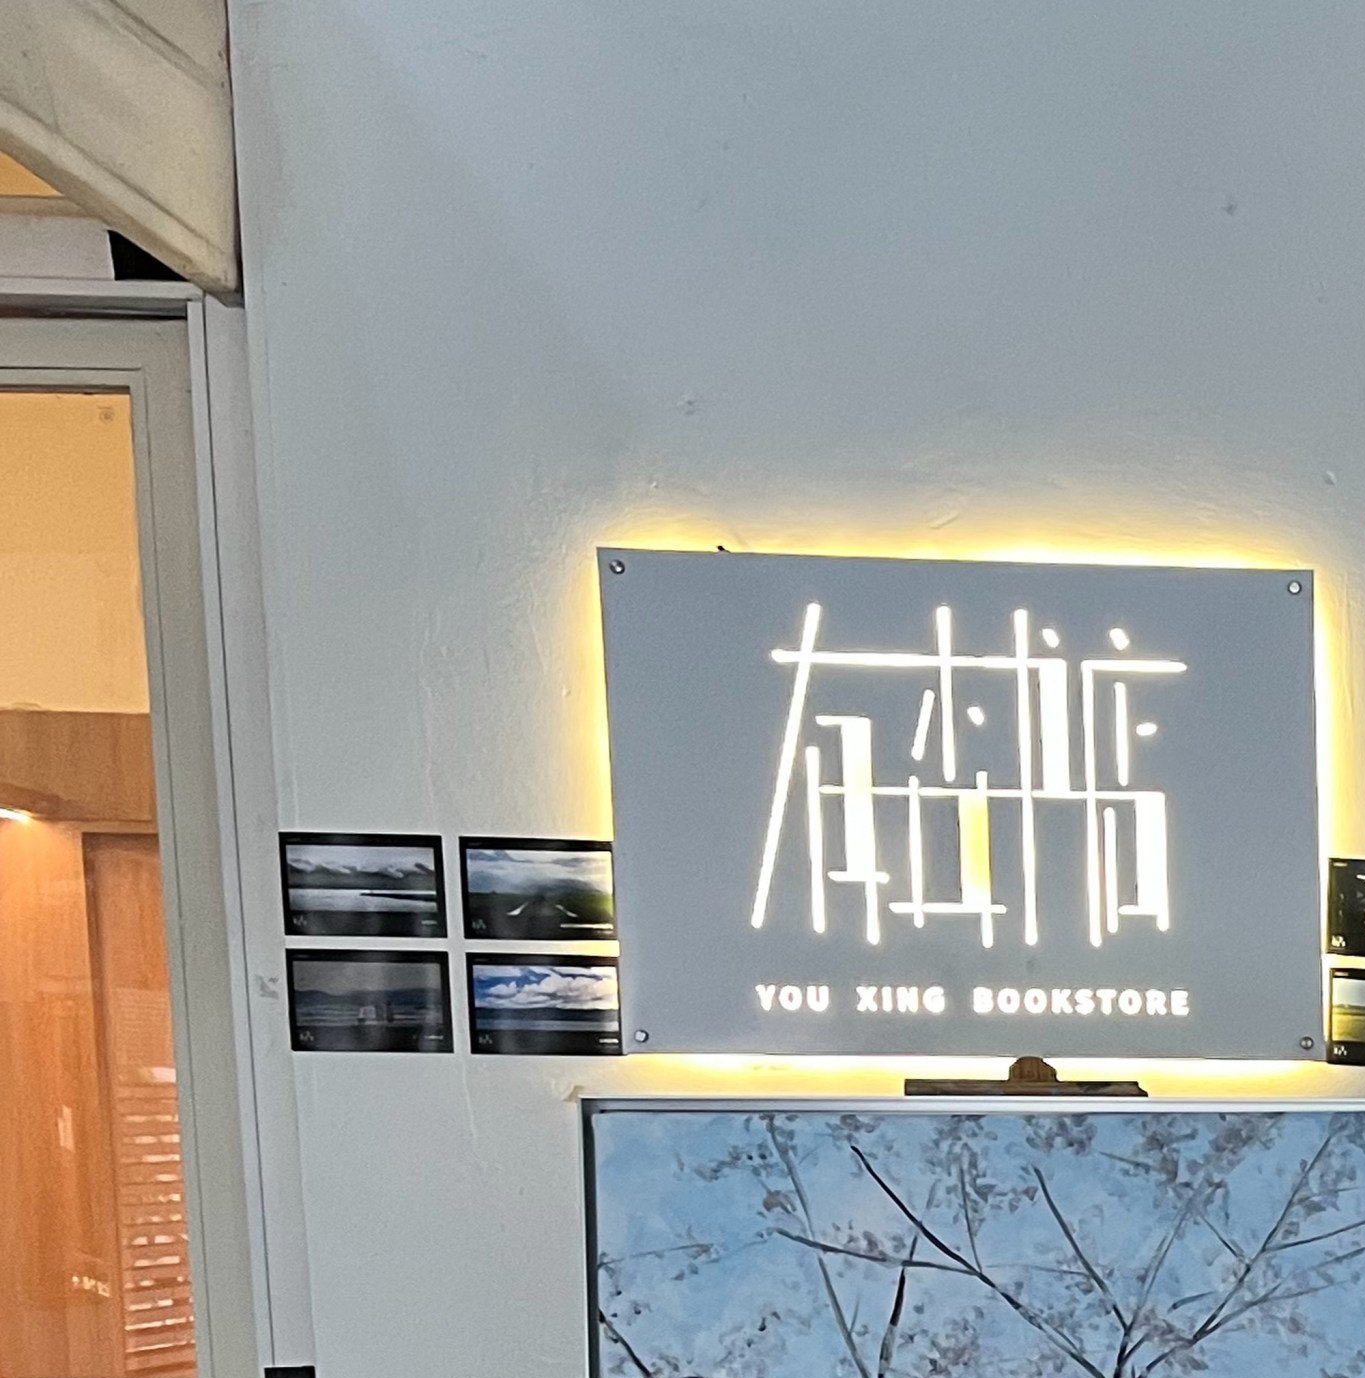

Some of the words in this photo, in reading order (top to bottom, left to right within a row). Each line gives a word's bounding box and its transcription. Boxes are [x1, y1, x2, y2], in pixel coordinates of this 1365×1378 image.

[755, 984, 830, 1013] YOU
[856, 985, 946, 1013] XING
[972, 986, 1190, 1016] BOOKSTORE
